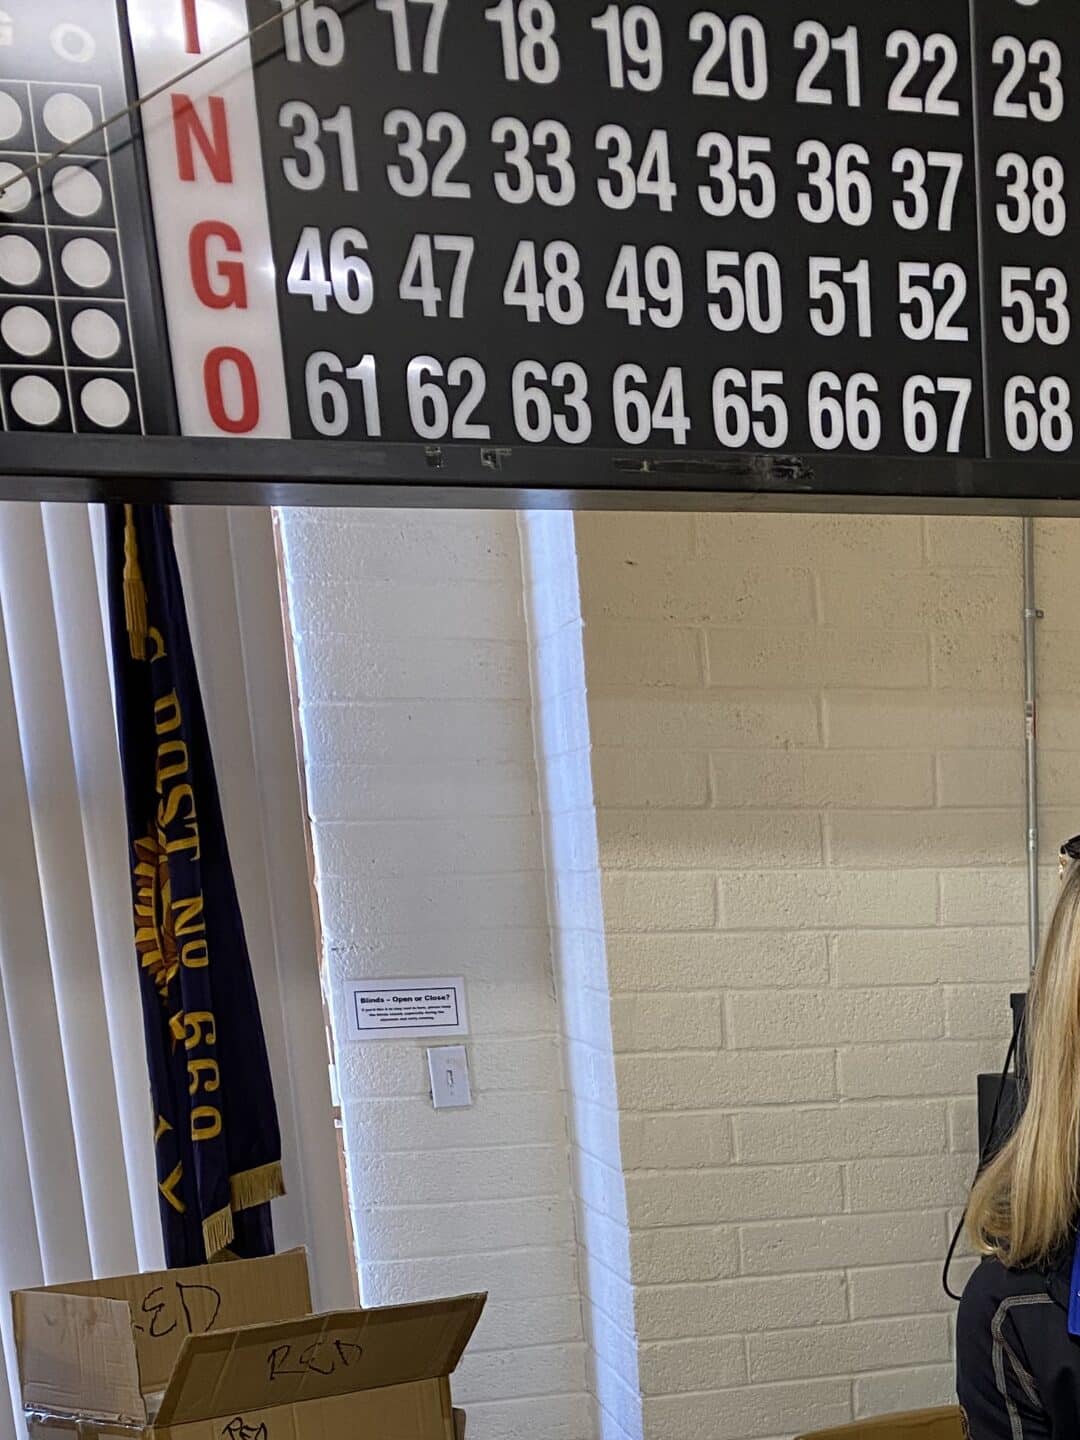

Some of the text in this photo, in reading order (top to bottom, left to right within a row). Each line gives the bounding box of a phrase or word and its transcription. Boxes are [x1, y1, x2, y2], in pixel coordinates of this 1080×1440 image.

[283, 0, 345, 67] 16
[376, 0, 448, 74] 17
[485, 0, 560, 84] 18
[591, 5, 663, 92] 19
[689, 12, 768, 101] 20
[793, 20, 861, 107] 21
[885, 30, 959, 116] 22
[991, 36, 1064, 122] 23
[279, 101, 359, 192] 31
[383, 110, 471, 199] 32
[491, 117, 576, 207] 33
[595, 124, 677, 212] 34
[696, 132, 776, 219] 35
[796, 140, 872, 227] 36
[891, 148, 963, 232] 37
[995, 153, 1066, 237] 38
[286, 227, 374, 315] 46
[399, 234, 474, 319] 47
[503, 240, 584, 325] 48
[605, 245, 684, 329] 49
[706, 250, 783, 334] 50
[808, 256, 872, 338] 51
[898, 261, 969, 342] 52
[1001, 266, 1070, 345] 53
[305, 351, 381, 437] 61
[406, 355, 491, 440] 62
[511, 360, 592, 444] 63
[612, 363, 691, 445] 64
[712, 367, 789, 449] 65
[807, 371, 881, 451] 66
[902, 374, 972, 453] 67
[1004, 375, 1073, 452] 68
[360, 996, 385, 1004] Blinds
[392, 996, 413, 1004] Open
[424, 993, 450, 1001] Close?
[134, 1281, 221, 1337] ED
